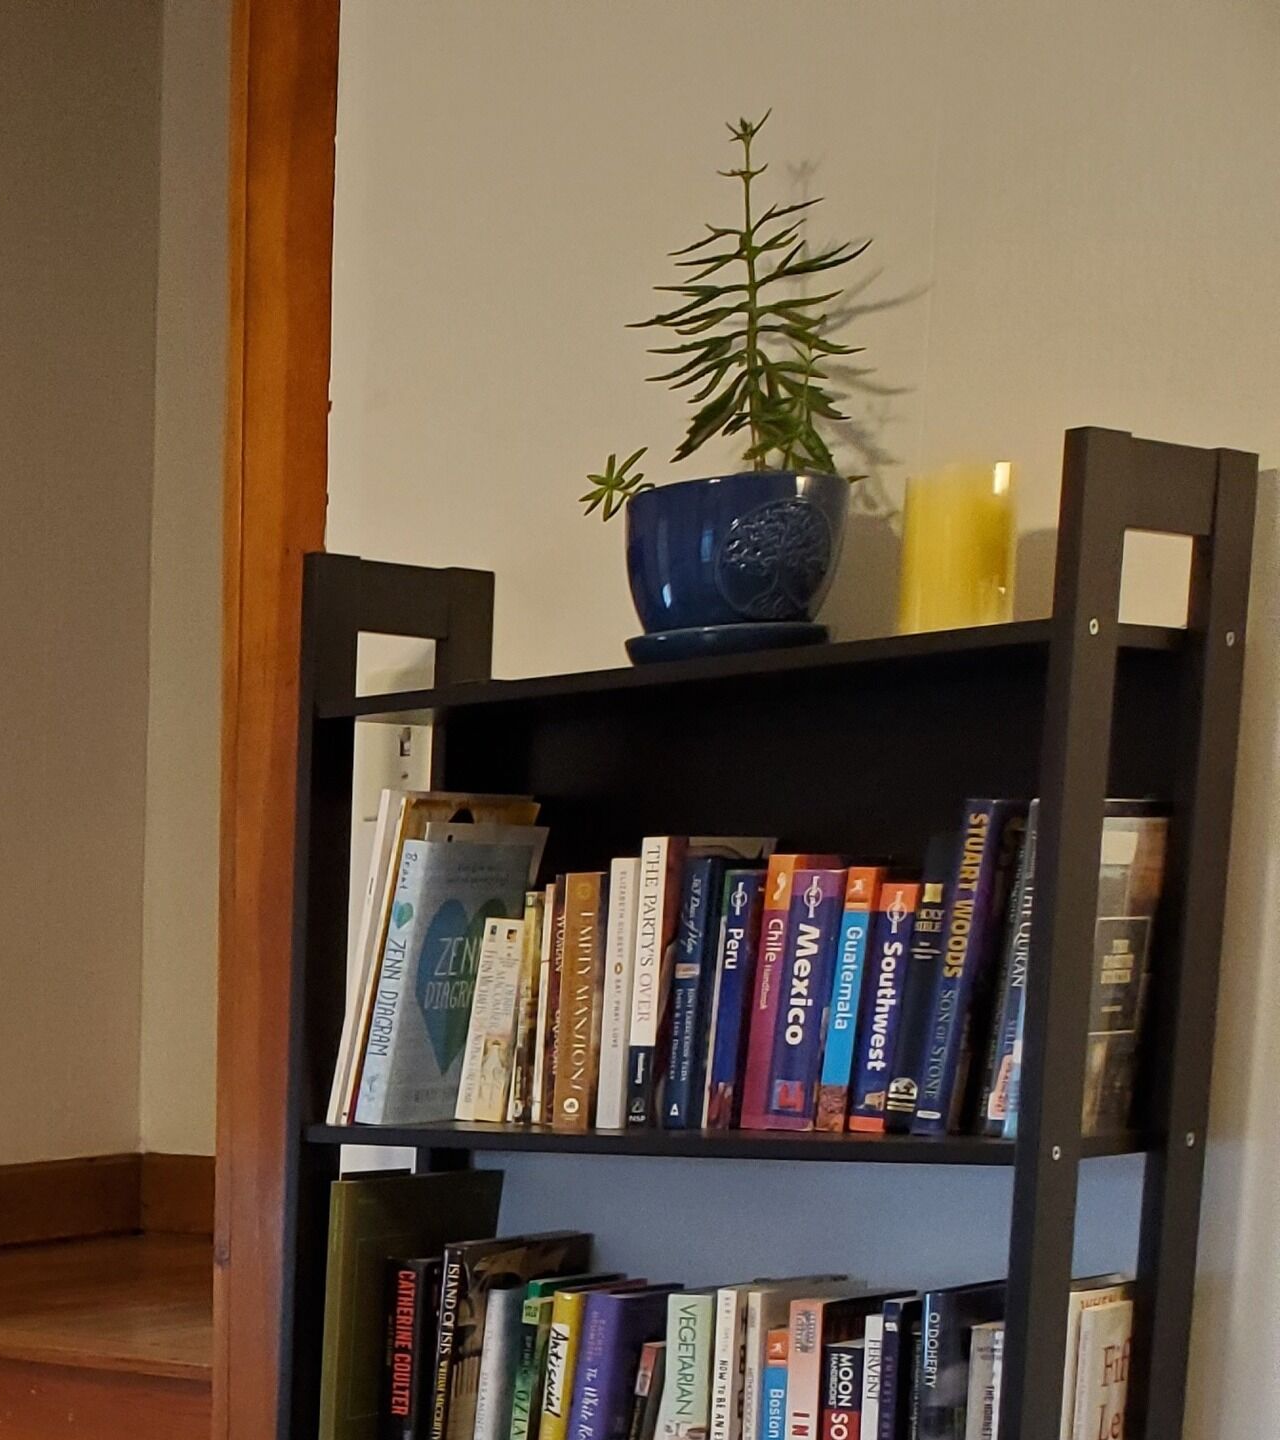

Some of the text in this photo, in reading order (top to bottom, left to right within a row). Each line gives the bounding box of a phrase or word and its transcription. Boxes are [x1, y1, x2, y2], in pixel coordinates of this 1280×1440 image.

[943, 813, 989, 979] STUART WOODS
[385, 938, 407, 981] ZENN
[636, 845, 660, 1023] THE PARTY'S OVER
[723, 928, 744, 970] Peru
[765, 918, 784, 963] Chile
[1011, 922, 1031, 987] QURAN
[572, 912, 594, 1090] EMPTY MANSIONS
[785, 924, 820, 1046] Mexico
[834, 926, 863, 1030] Guatemala
[867, 941, 903, 1071] Southwest
[937, 990, 955, 1027] SON
[368, 989, 399, 1057] DIAGRAM
[925, 1047, 944, 1099] STONE
[440, 1263, 460, 1356] ISLAND OF ISIS
[391, 1270, 416, 1417] CATHERINE COULTER
[544, 1326, 569, 1418] Antisocial
[675, 1303, 698, 1416] VEGETARIAN
[719, 1359, 728, 1381] HOW
[866, 1339, 881, 1399] FERVENT
[924, 1312, 941, 1389] O'DOHERTY
[581, 1386, 599, 1422] White
[716, 1396, 726, 1408] BE
[828, 1353, 838, 1406] HANDBOOKS
[838, 1353, 853, 1407] MOON
[715, 1413, 725, 1428] AN
[767, 1388, 785, 1439] Boston
